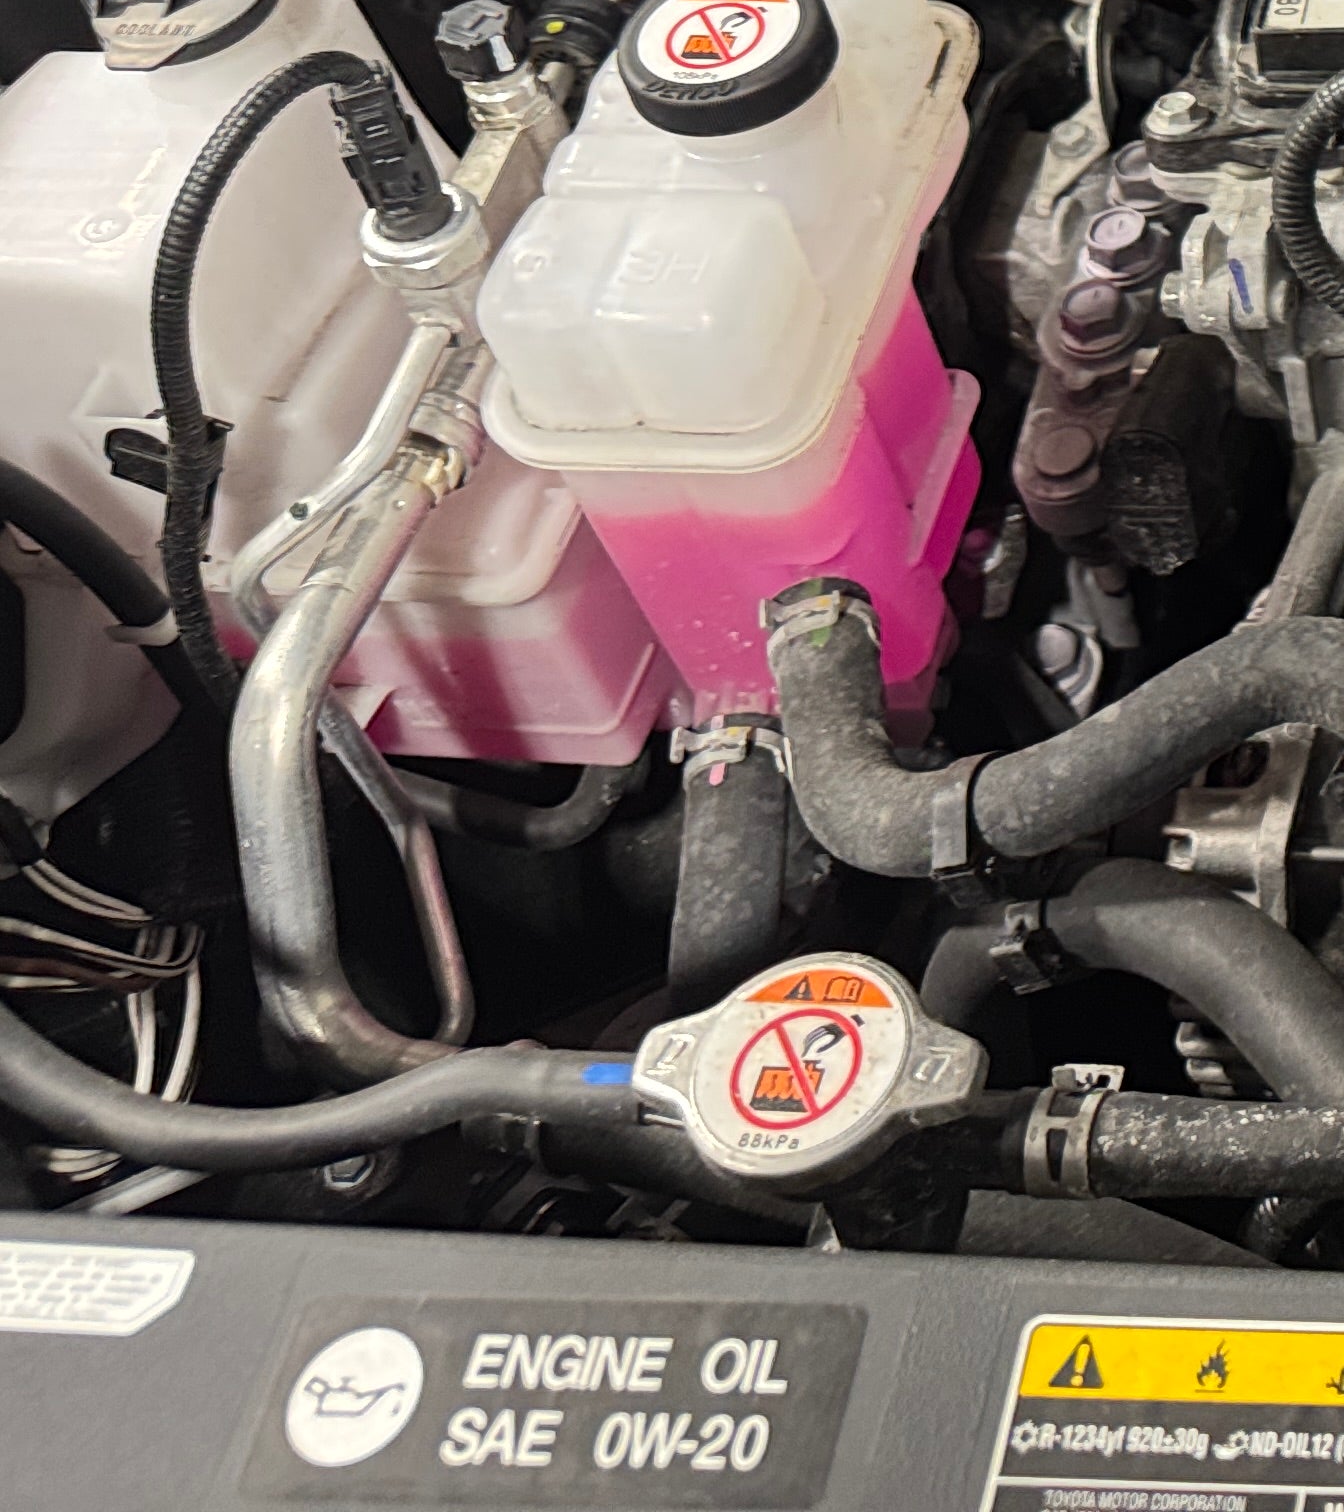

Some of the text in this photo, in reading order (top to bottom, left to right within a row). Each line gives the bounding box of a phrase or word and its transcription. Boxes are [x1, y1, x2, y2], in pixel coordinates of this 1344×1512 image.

[738, 1132, 800, 1150] 88kPa
[463, 1333, 788, 1395] ENGINE OIL
[438, 1406, 771, 1473] SAE 0W-20
[1042, 1489, 1248, 1512] TOYOTA MOTOR CORPORATION
